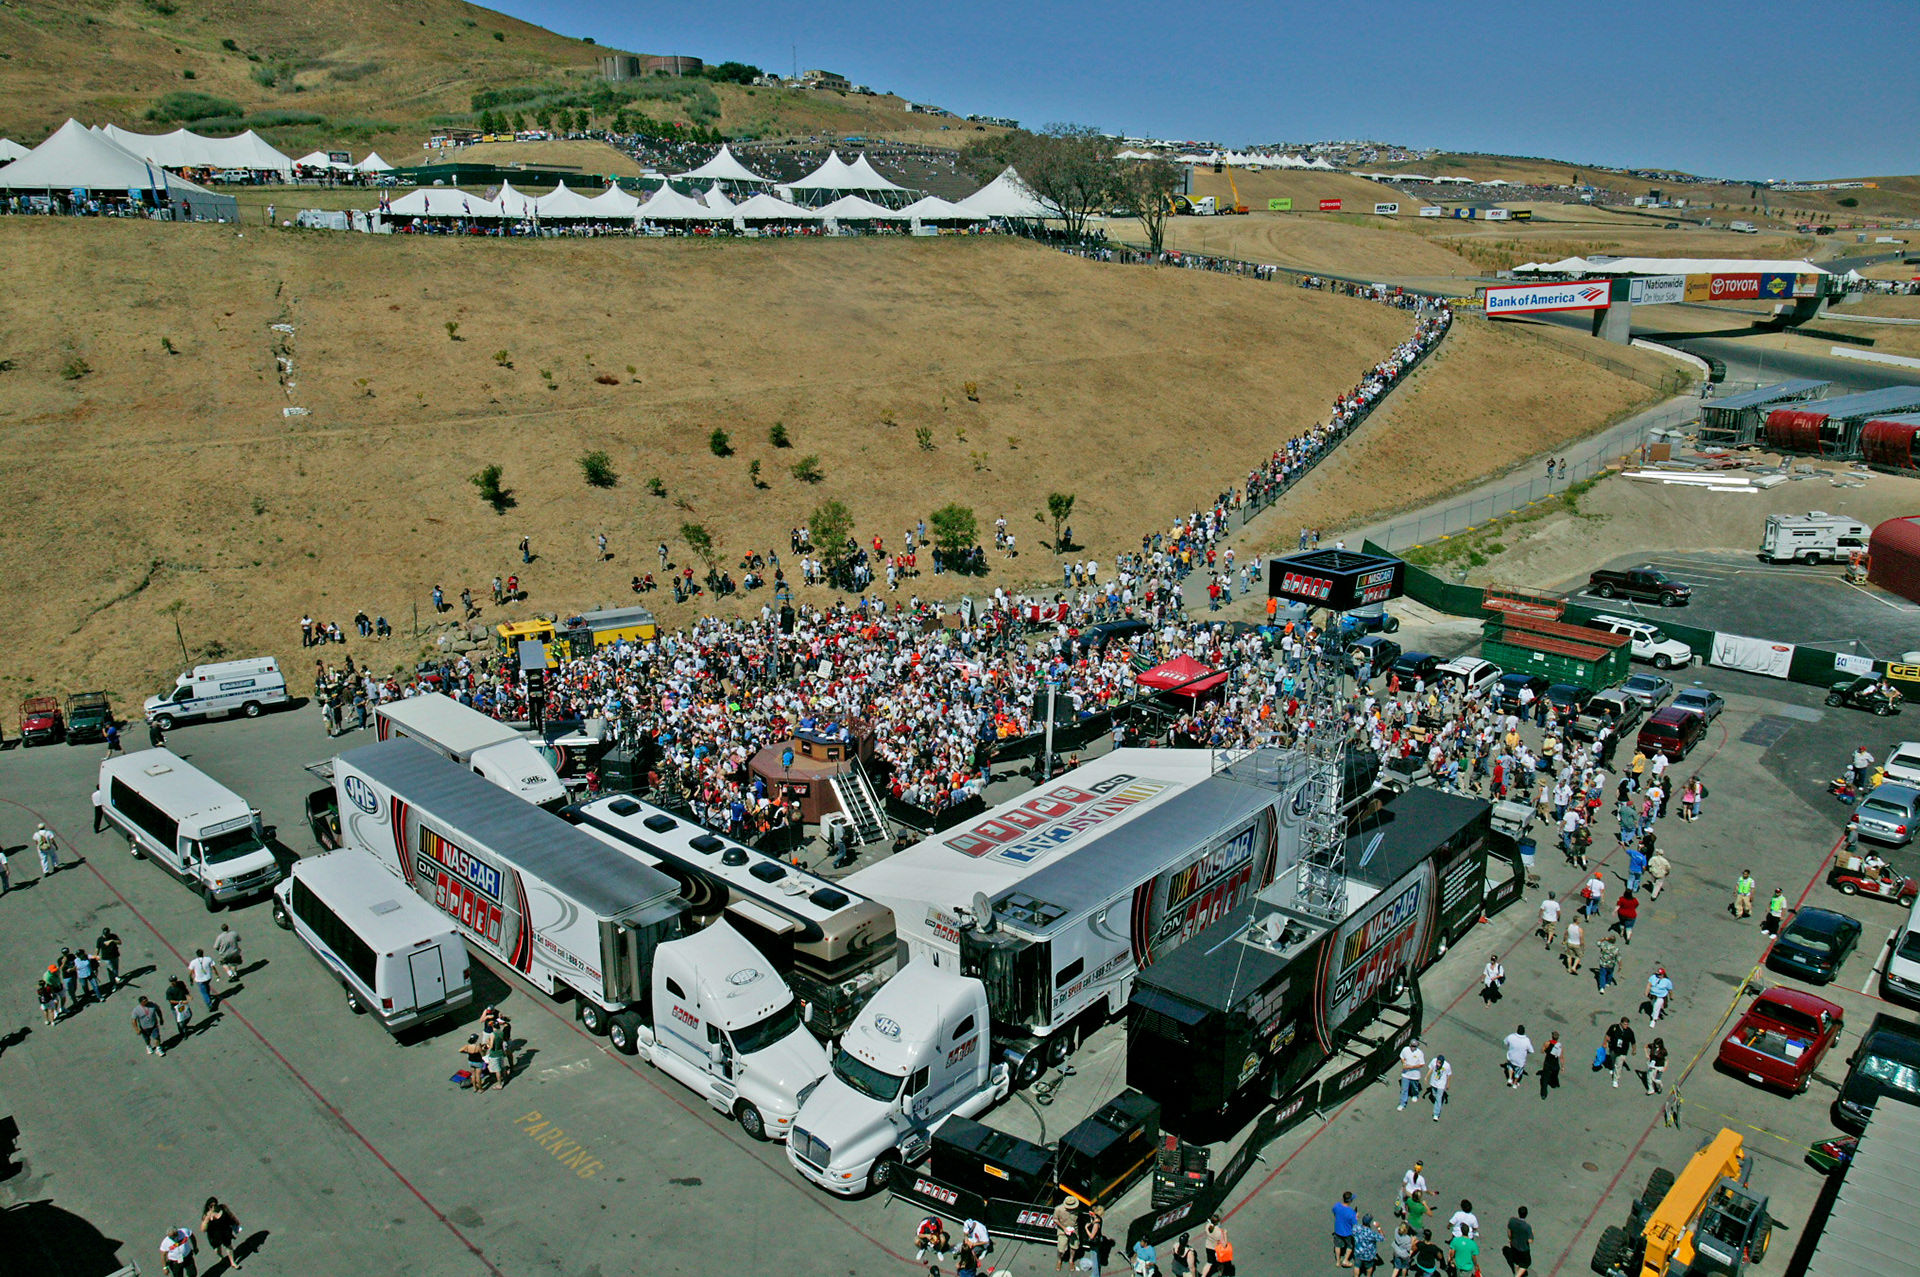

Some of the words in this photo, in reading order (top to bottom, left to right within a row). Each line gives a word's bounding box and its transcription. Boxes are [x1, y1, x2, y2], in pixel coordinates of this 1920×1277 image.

[1644, 294, 1652, 302] On
[1652, 293, 1664, 302] Your
[1665, 292, 1677, 301] Side
[1645, 278, 1684, 290] Nationwide
[1724, 279, 1759, 292] TOYOTA
[1490, 295, 1517, 308] Bank
[1518, 294, 1530, 306] of
[1530, 292, 1575, 305] America
[1281, 574, 1332, 600] SPEED
[1368, 570, 1392, 584] NASCAR
[1362, 585, 1391, 603] SPEED
[1836, 657, 1848, 667] SCI
[1891, 664, 1920, 677] GE
[346, 777, 376, 810] JHE
[1095, 776, 1131, 792] ON
[947, 786, 1090, 855] SPEED
[1001, 802, 1128, 862] NASCAR
[442, 842, 497, 896] NASCAR
[1195, 832, 1251, 889] NASCAR
[418, 861, 434, 878] ON
[436, 876, 501, 943] SPEED
[1162, 912, 1183, 936] ON
[1181, 870, 1250, 944] SPEED
[1366, 888, 1416, 949] NASCAR
[1334, 976, 1354, 1002] ON
[1350, 926, 1414, 1010] SPEED
[1059, 992, 1067, 1004] Get
[1068, 981, 1083, 997] SPEED
[876, 1017, 901, 1035] JHE
[514, 1110, 604, 1178] PARKING
[913, 1178, 958, 1205] SPEED
